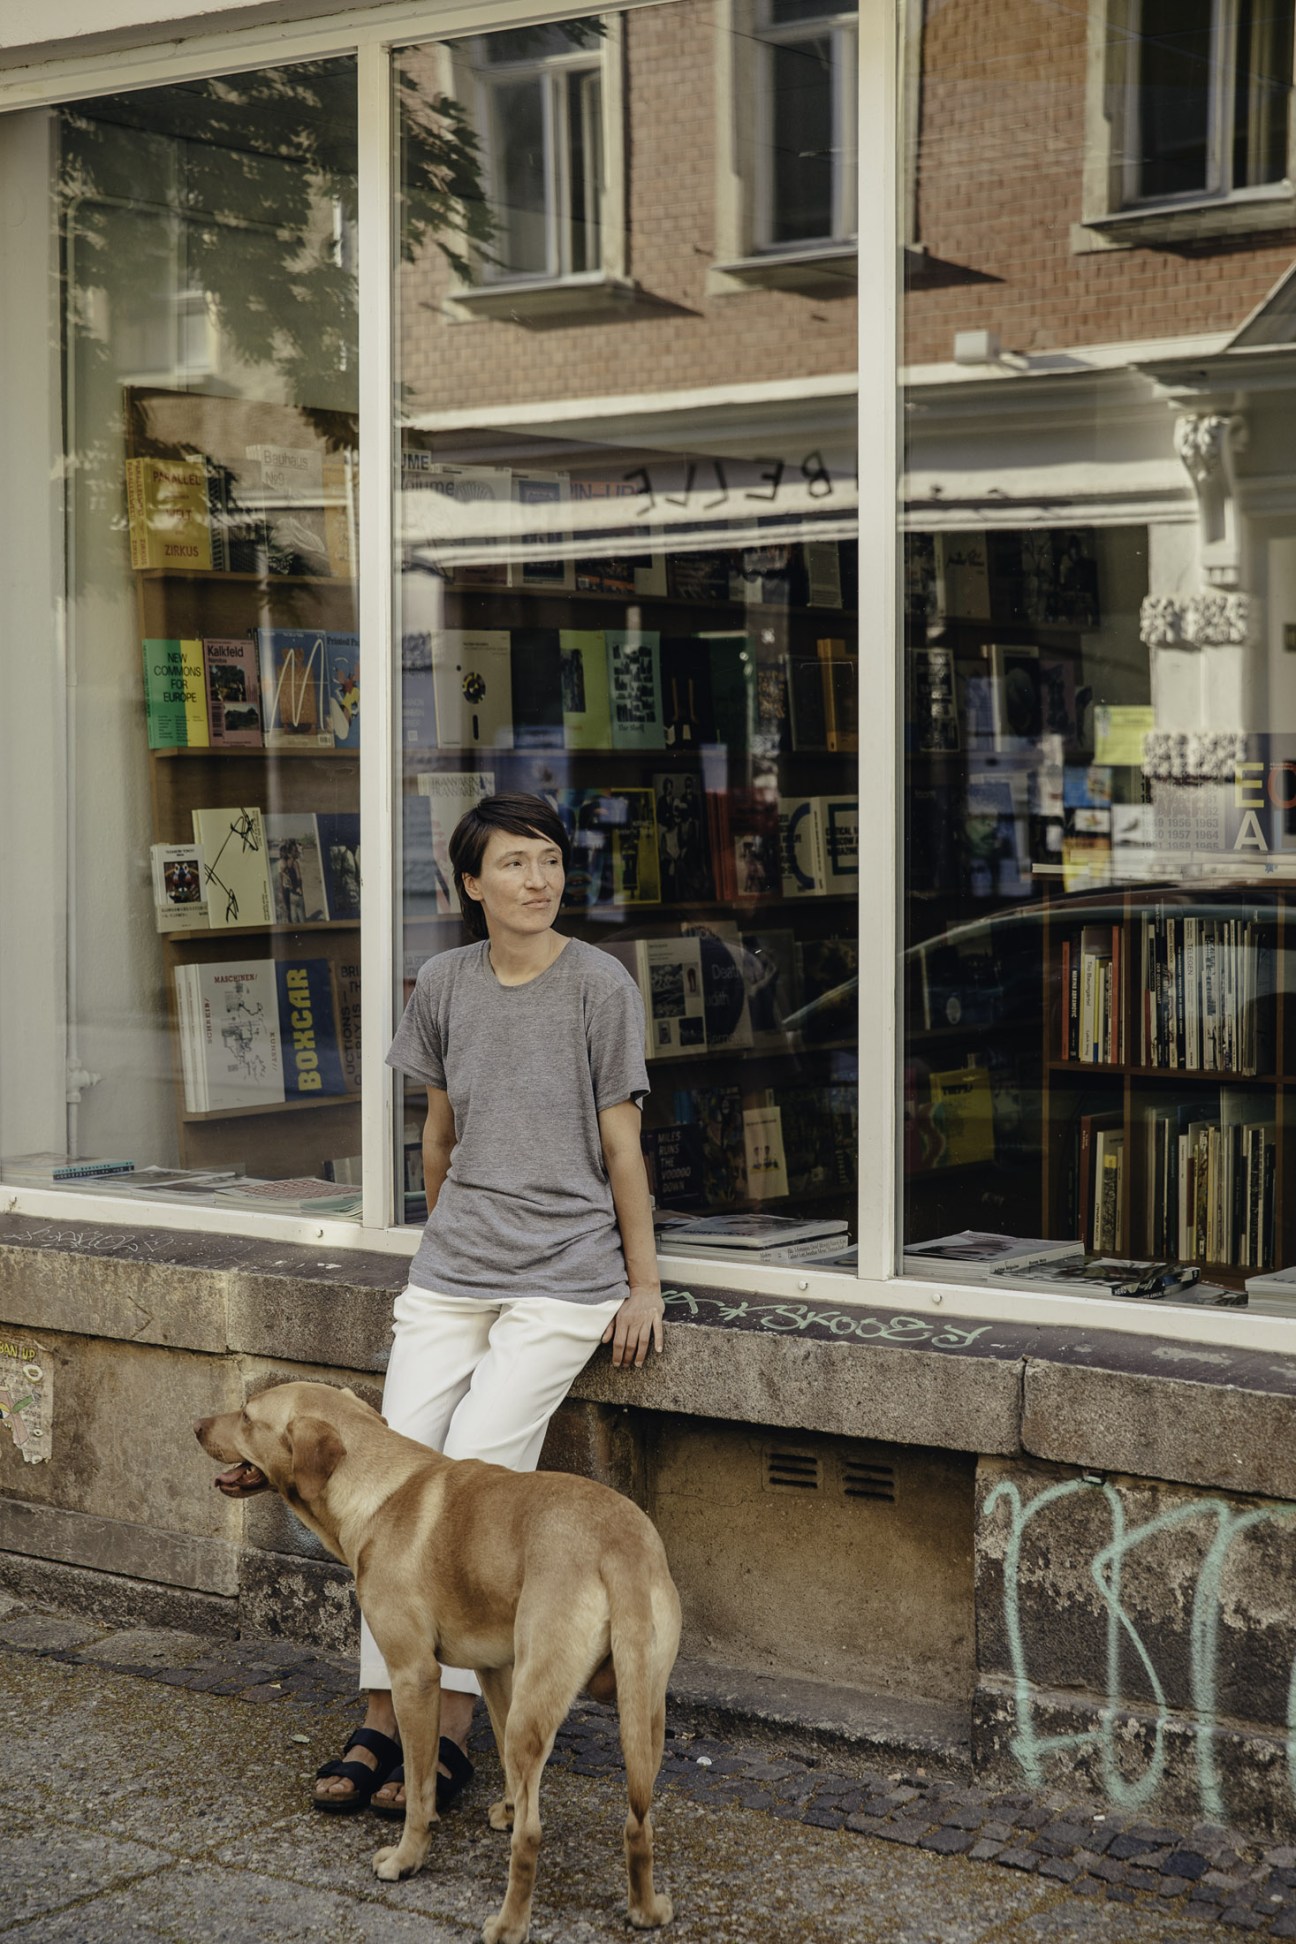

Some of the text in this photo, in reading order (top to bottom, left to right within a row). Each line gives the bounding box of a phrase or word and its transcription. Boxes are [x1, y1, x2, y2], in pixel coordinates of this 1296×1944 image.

[264, 450, 309, 469] Bauhaus
[153, 471, 202, 486] PARALLEL
[164, 544, 199, 558] ZIRKUS
[207, 645, 244, 658] Kalkfeld
[167, 652, 187, 664] NEW
[153, 665, 202, 677] COMMONS
[170, 678, 188, 690] FOR
[163, 690, 197, 703] EUROPE
[1167, 818, 1219, 828] 1956 1963
[1167, 830, 1219, 840] 1957 1964
[286, 968, 323, 1091] BOXCAR
[658, 1131, 681, 1144] MILES
[658, 1144, 680, 1156] RUNS
[660, 1157, 675, 1168] THE
[662, 1181, 685, 1193] DOWN
[22, 1347, 36, 1360] UP
